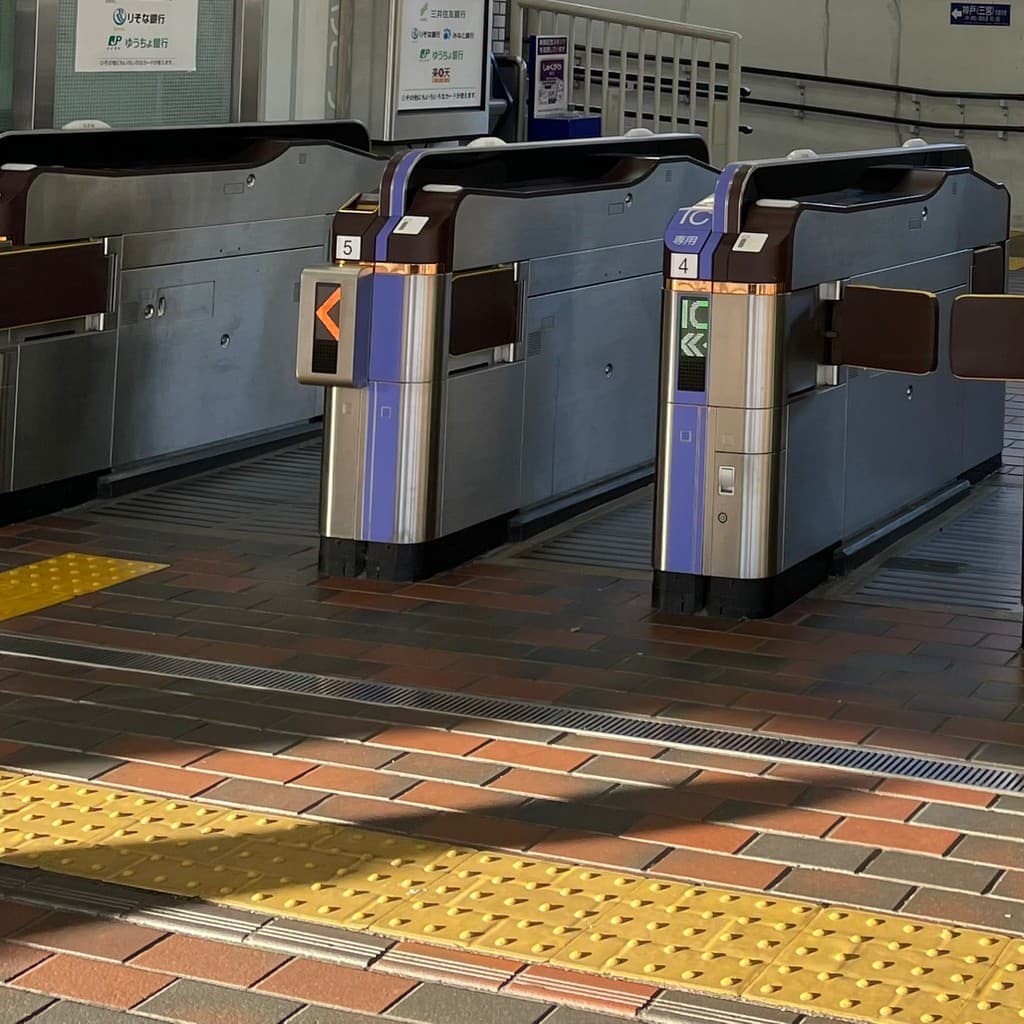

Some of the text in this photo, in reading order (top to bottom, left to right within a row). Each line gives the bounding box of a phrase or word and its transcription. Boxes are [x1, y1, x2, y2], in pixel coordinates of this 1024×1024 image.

[127, 13, 166, 25] りそな銀行
[125, 37, 169, 49] ゆうちょ銀行
[679, 209, 711, 225] IC
[342, 239, 353, 256] 5
[672, 234, 699, 247] 専用
[677, 257, 689, 274] 4
[681, 299, 710, 330] IC
